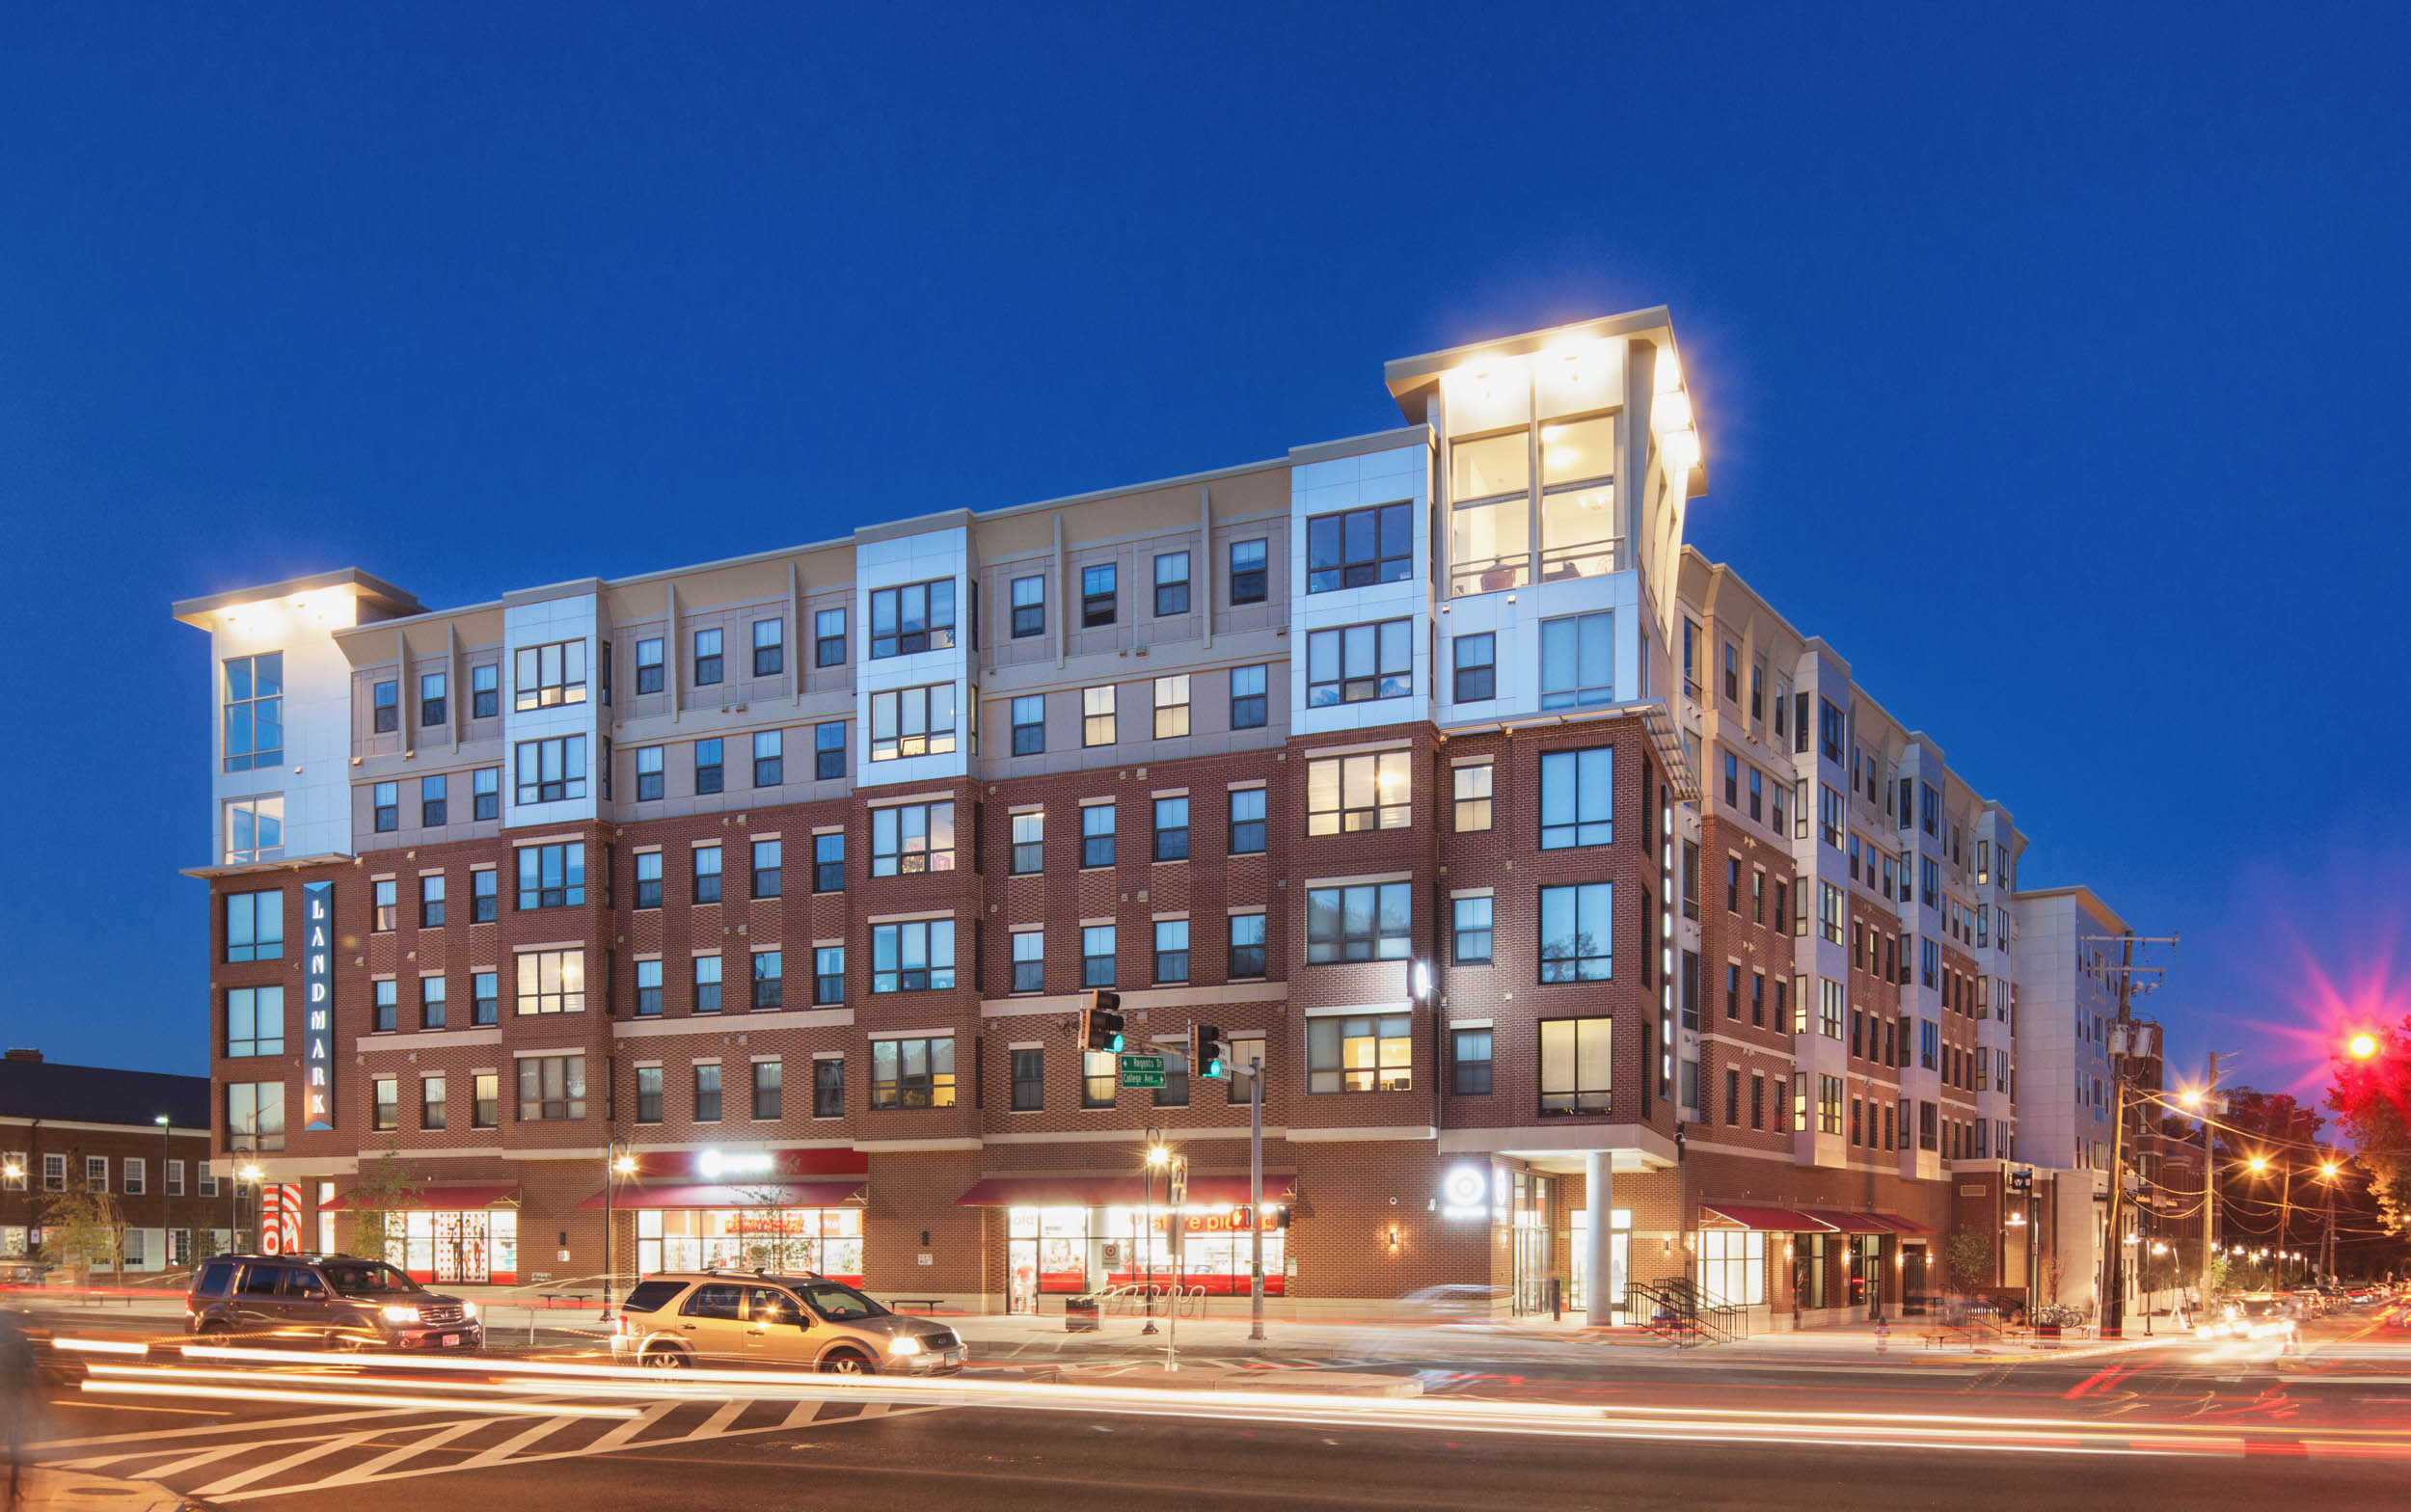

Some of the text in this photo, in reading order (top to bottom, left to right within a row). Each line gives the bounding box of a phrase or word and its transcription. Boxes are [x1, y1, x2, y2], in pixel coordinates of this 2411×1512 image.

[311, 899, 326, 1115] LANDMARK
[1133, 1058, 1154, 1070] Regents
[1123, 1072, 1142, 1086] College
[1151, 1214, 1276, 1233] stre picp
